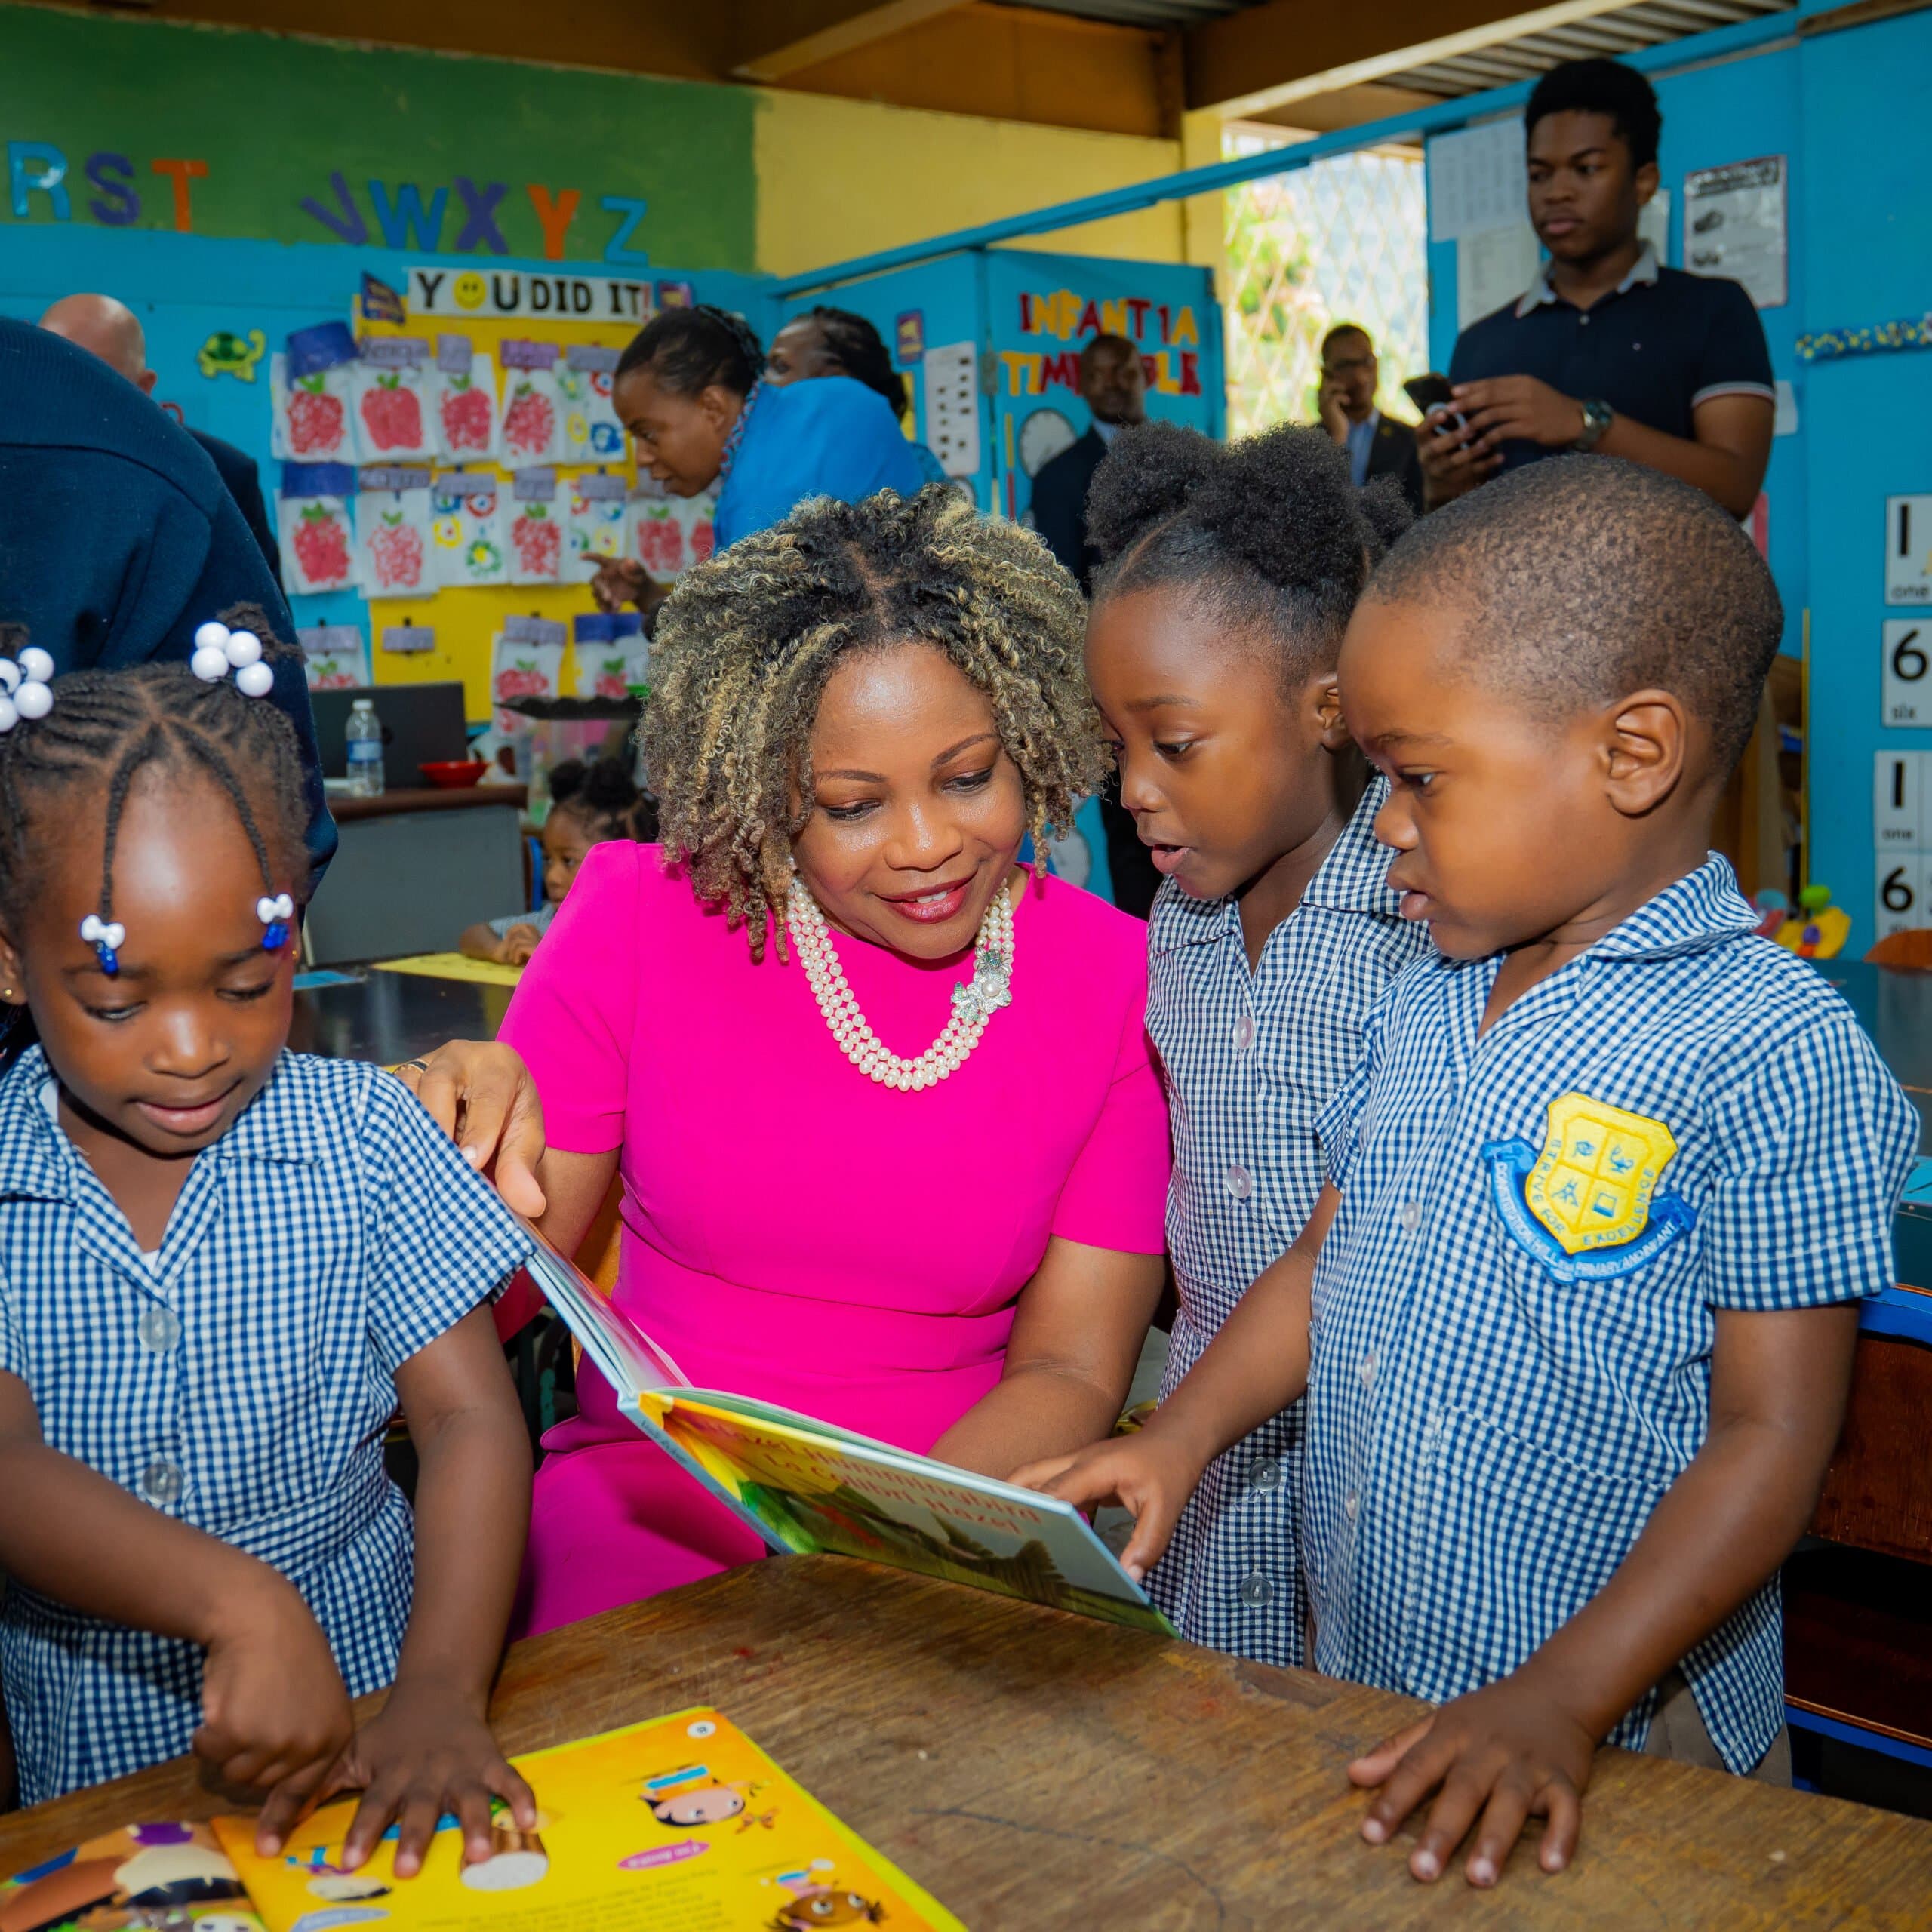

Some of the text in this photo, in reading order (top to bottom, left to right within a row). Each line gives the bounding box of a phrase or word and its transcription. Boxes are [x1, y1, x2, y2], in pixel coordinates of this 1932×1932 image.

[531, 279, 592, 314] DID
[1020, 289, 1151, 340] INFANT
[1891, 585, 1930, 599] one
[1892, 629, 1928, 681] 6
[1891, 703, 1917, 720] six
[1882, 827, 1915, 842] one
[1881, 866, 1914, 912] 6
[1531, 1139, 1562, 1203] STRIVE
[1540, 1209, 1567, 1235] FOR
